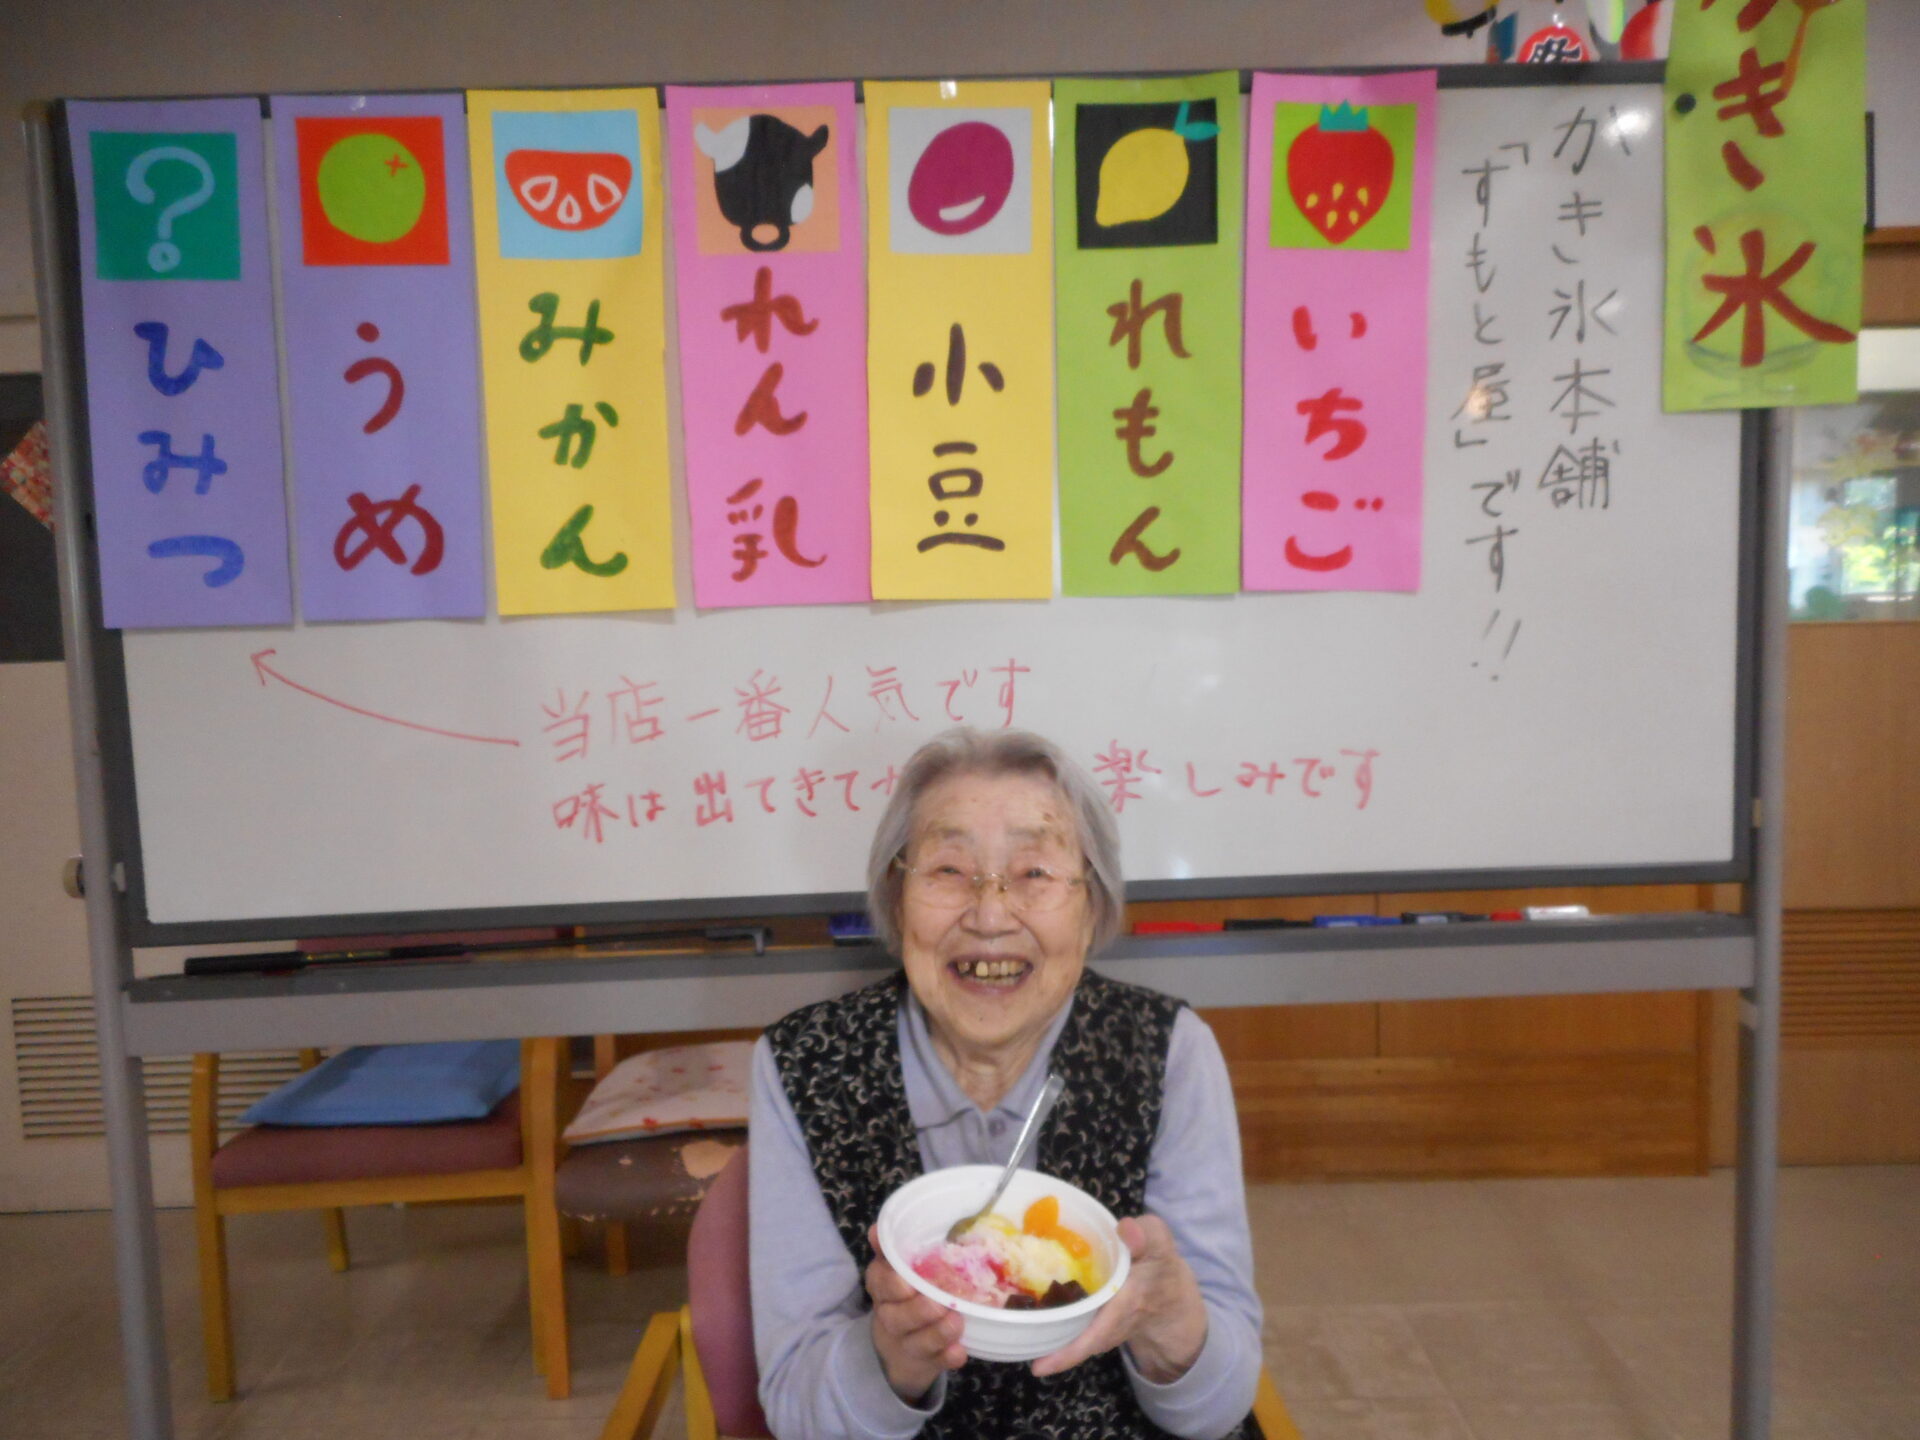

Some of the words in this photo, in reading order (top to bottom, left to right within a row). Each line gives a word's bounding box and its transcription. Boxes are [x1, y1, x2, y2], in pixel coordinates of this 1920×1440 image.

[1688, 0, 1857, 367] き氷
[133, 322, 245, 588] ひみつ
[333, 322, 445, 576] うめ
[518, 292, 629, 577] みかん
[720, 266, 828, 582] れん乳
[912, 323, 1006, 553] 小豆
[1106, 278, 1191, 572] れもん
[1284, 305, 1384, 572] いちご
